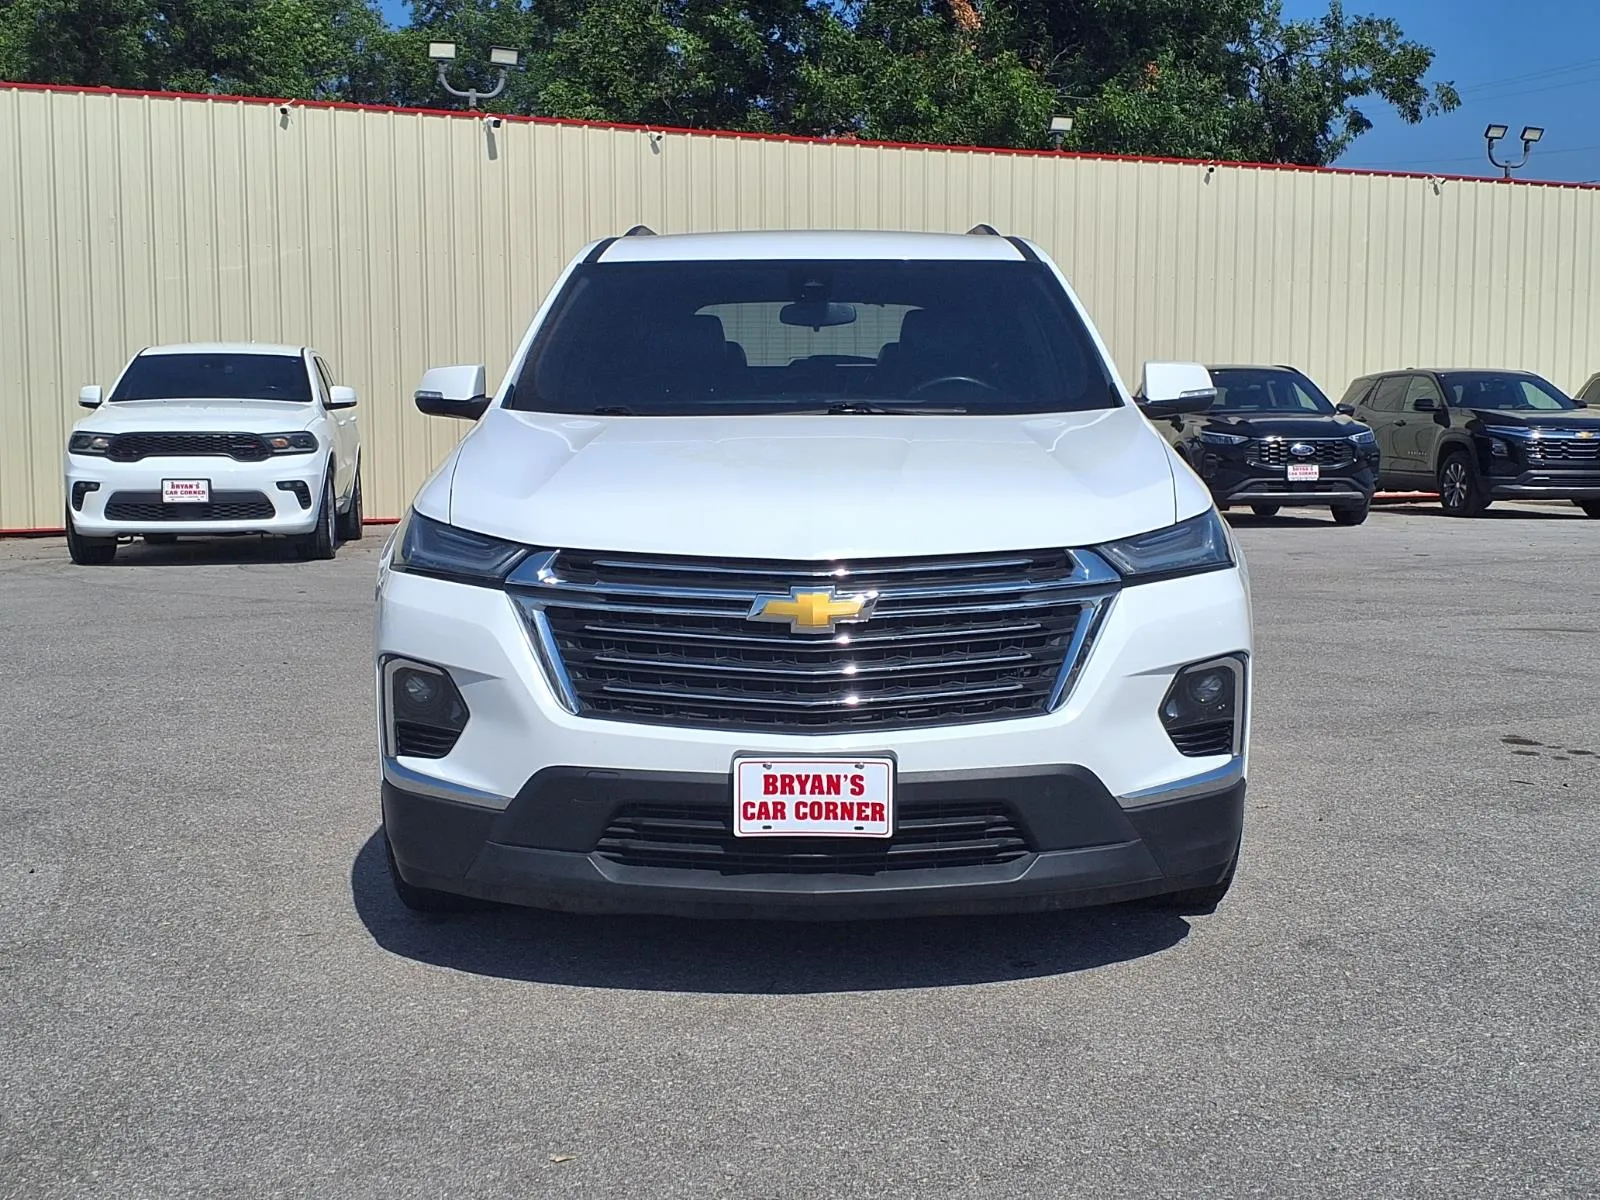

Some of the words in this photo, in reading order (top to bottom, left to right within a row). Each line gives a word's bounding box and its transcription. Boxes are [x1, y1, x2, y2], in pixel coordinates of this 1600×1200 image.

[763, 774, 865, 796] BRYAN'S
[742, 801, 786, 820] CAR
[794, 801, 885, 821] CORNER
